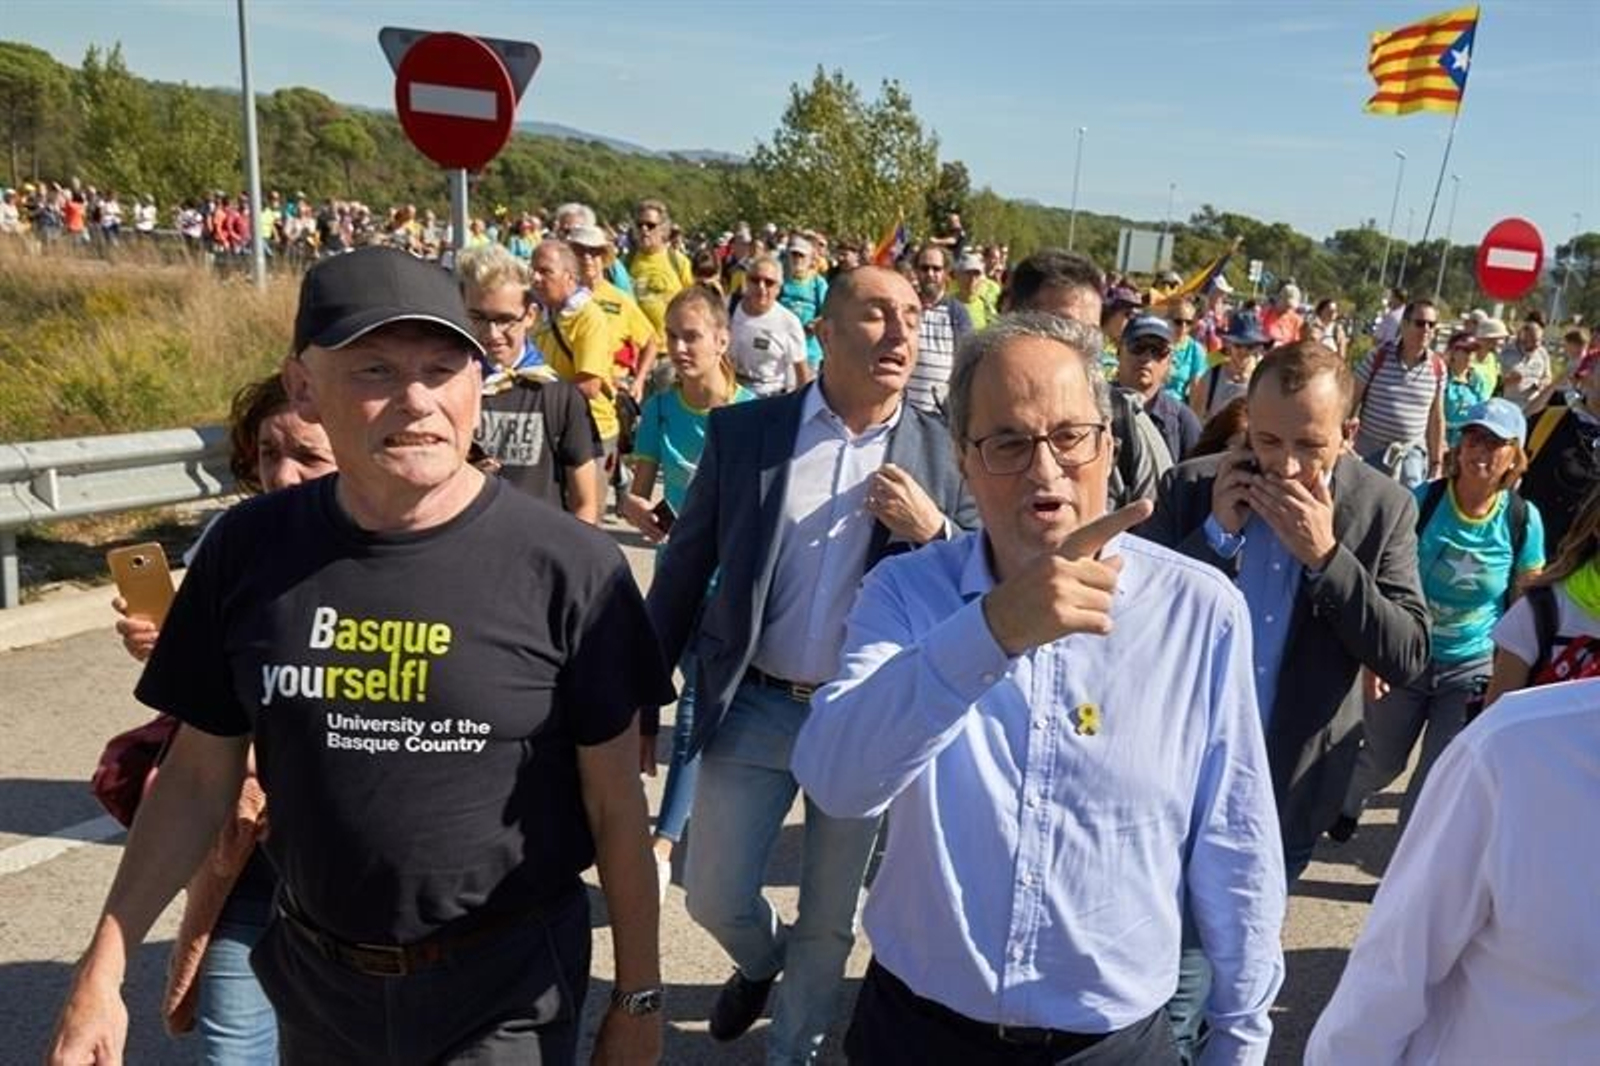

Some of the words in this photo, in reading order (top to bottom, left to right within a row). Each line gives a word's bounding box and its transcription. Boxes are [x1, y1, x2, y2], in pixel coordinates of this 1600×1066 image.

[308, 606, 452, 656] Basque
[261, 657, 429, 706] yourself!
[326, 712, 425, 737] University
[430, 718, 452, 736] of
[457, 719, 491, 736] the
[326, 731, 400, 755] Basque
[404, 735, 487, 754] Country
